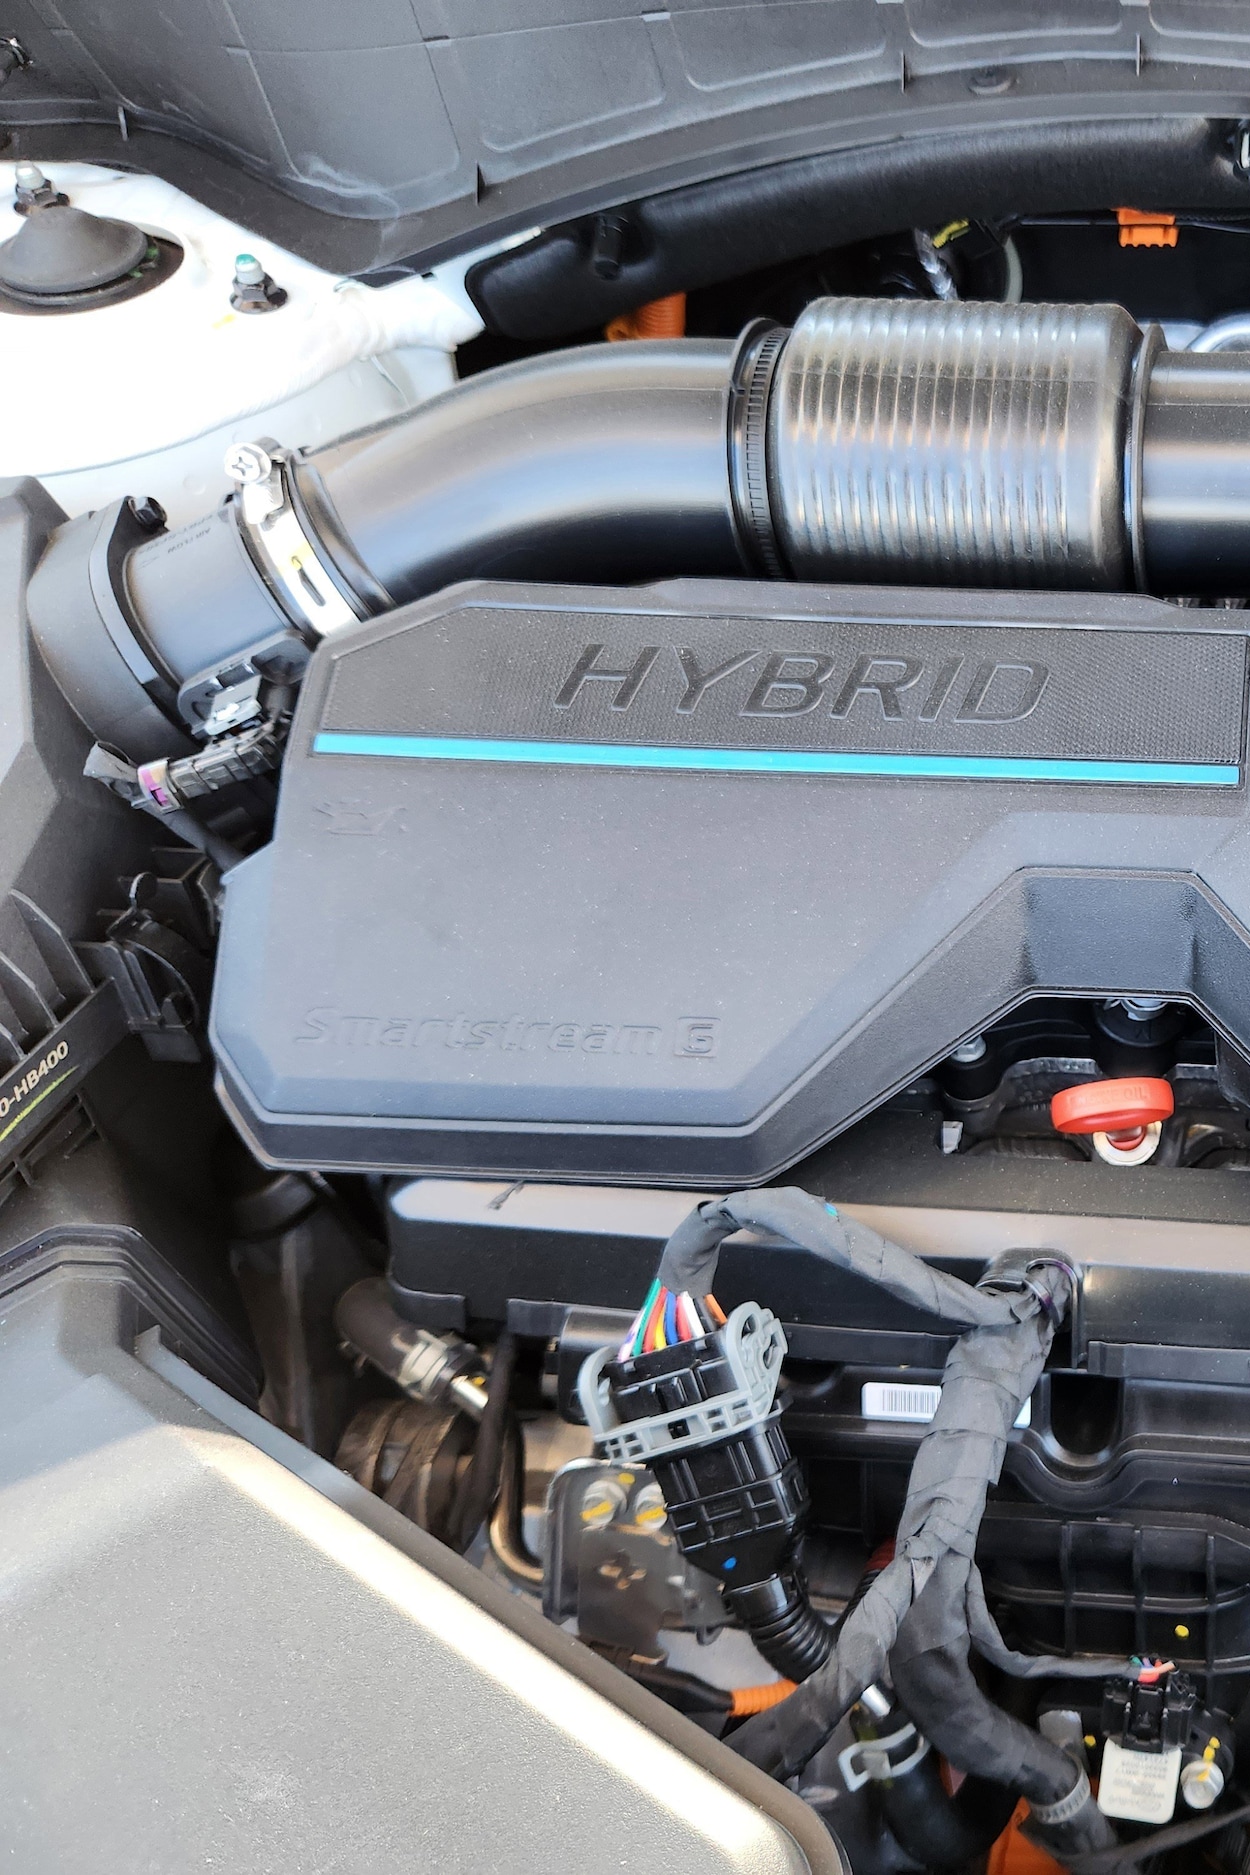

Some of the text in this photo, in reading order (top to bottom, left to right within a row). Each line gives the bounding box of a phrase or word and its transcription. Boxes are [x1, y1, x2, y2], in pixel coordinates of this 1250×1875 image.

[553, 643, 1051, 725] HYBRID
[295, 1006, 662, 1055] Smartstream
[1123, 1086, 1148, 1101] OIL
